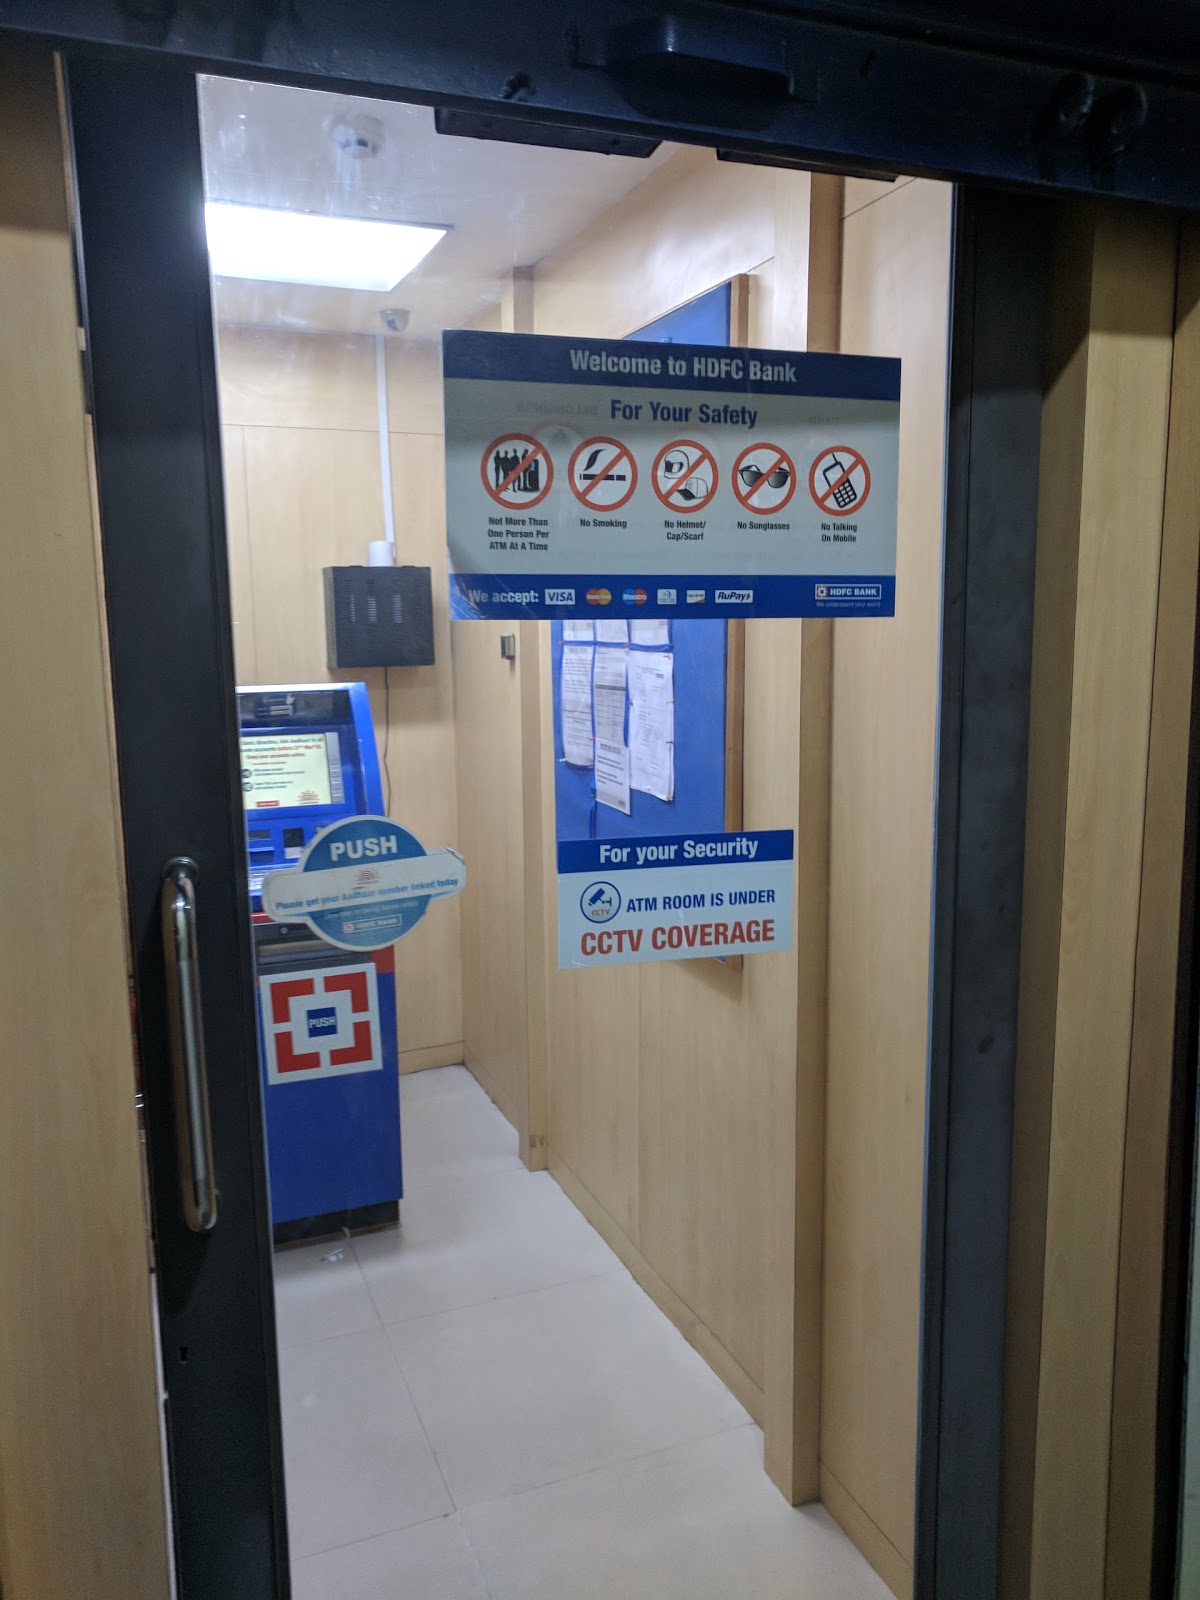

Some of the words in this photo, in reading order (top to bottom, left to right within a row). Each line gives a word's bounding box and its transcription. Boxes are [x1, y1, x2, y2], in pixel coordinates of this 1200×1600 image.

[570, 349, 662, 375] Welcome
[667, 357, 687, 376] to
[693, 357, 744, 379] HDFC
[750, 360, 797, 382] Bank
[611, 399, 642, 420] For
[650, 401, 692, 422] Your
[699, 403, 758, 429] Safety
[488, 517, 503, 526] Not
[505, 517, 526, 526] More
[528, 518, 548, 526] Than
[580, 519, 591, 527] No
[593, 519, 627, 529] Smoking
[664, 520, 674, 528] No
[676, 520, 706, 529] Helmet/
[737, 521, 747, 529] No
[749, 521, 790, 531] Sunglasses
[821, 523, 830, 531] No
[832, 523, 857, 532] Talking
[488, 529, 503, 538] One
[505, 529, 534, 539] Person
[536, 530, 549, 539] Per
[666, 532, 704, 541] Cap/Scarf
[821, 534, 831, 542] On
[833, 534, 856, 542] Mobile
[489, 541, 507, 550] ATM
[509, 542, 518, 550] At
[520, 542, 527, 550] A
[529, 542, 548, 551] Time
[830, 588, 852, 596] HDFC
[854, 588, 877, 596] BANK
[468, 590, 488, 603] We
[492, 590, 539, 605] accept:
[547, 591, 573, 602] VISA
[717, 592, 746, 602] RuPay
[330, 835, 398, 862] PUSH
[600, 845, 630, 863] For
[636, 844, 678, 865] your
[683, 837, 758, 858] Security
[276, 900, 303, 910] Please
[306, 896, 318, 908] get
[321, 895, 339, 905] your
[378, 884, 408, 895] number
[411, 880, 435, 891] linked
[437, 878, 459, 887] today
[626, 897, 657, 912] ATM
[663, 894, 705, 911] ROOM
[711, 892, 723, 906] IS
[729, 889, 775, 905] UNDER
[592, 908, 610, 916] CCTV
[581, 928, 643, 956] CCTV
[652, 919, 775, 951] COVERAGE
[309, 1016, 336, 1028] PUSH
